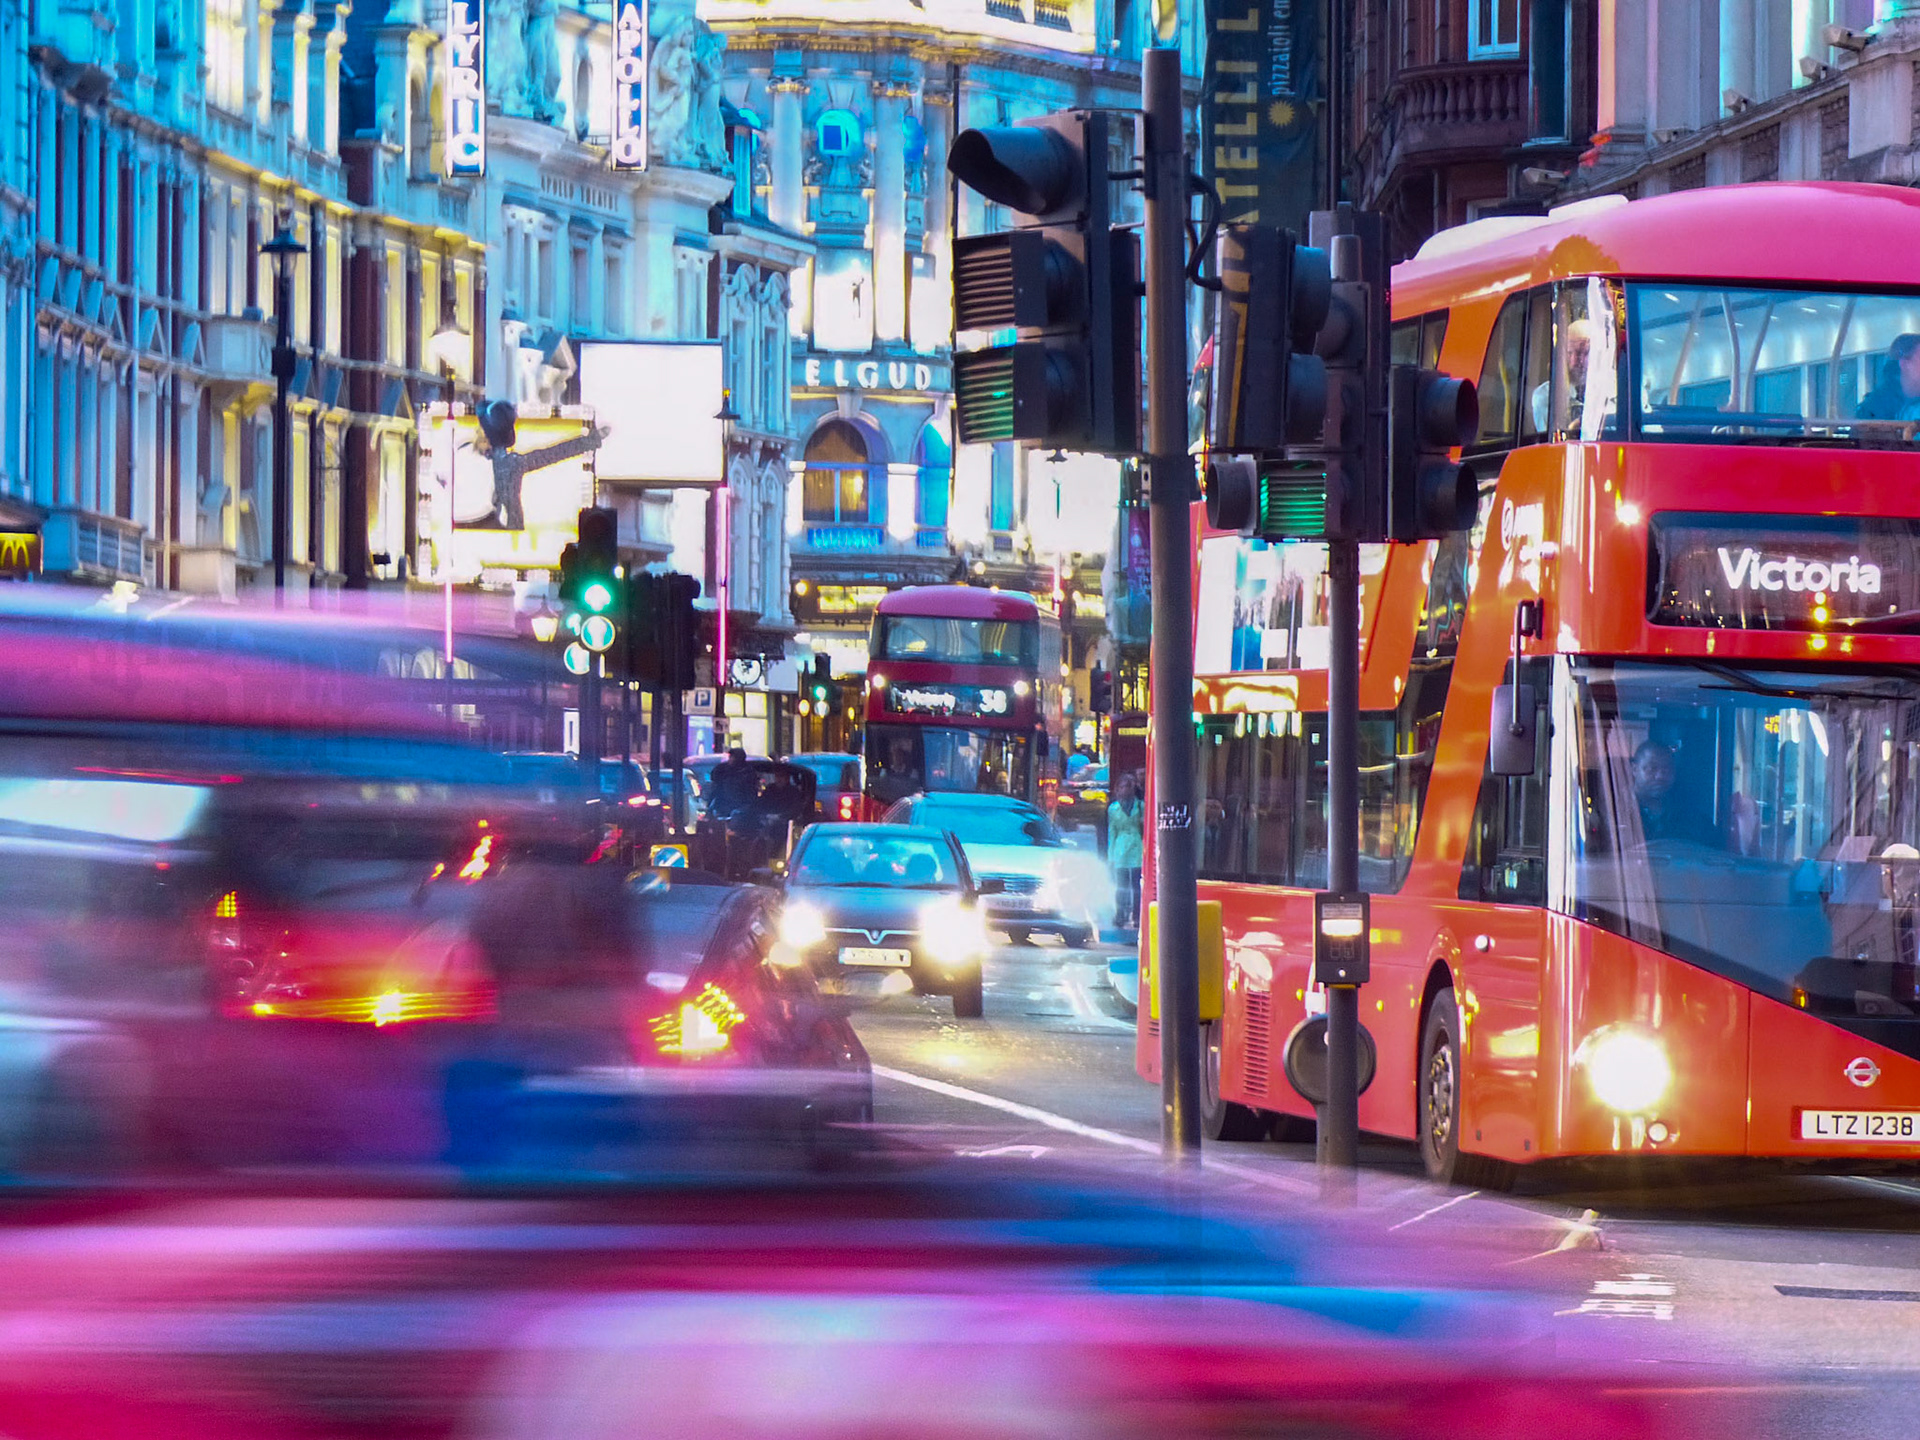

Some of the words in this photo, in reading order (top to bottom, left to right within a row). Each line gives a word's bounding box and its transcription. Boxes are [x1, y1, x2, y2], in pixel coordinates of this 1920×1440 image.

[452, 2, 480, 166] LYRIC
[614, 3, 643, 164] APOLLO
[1268, 25, 1296, 95] pizzaioli
[805, 359, 931, 390] ELGUD
[1717, 547, 1881, 594] Victoria
[1816, 1114, 1858, 1135] LTZ
[1865, 1115, 1913, 1136] 1238
